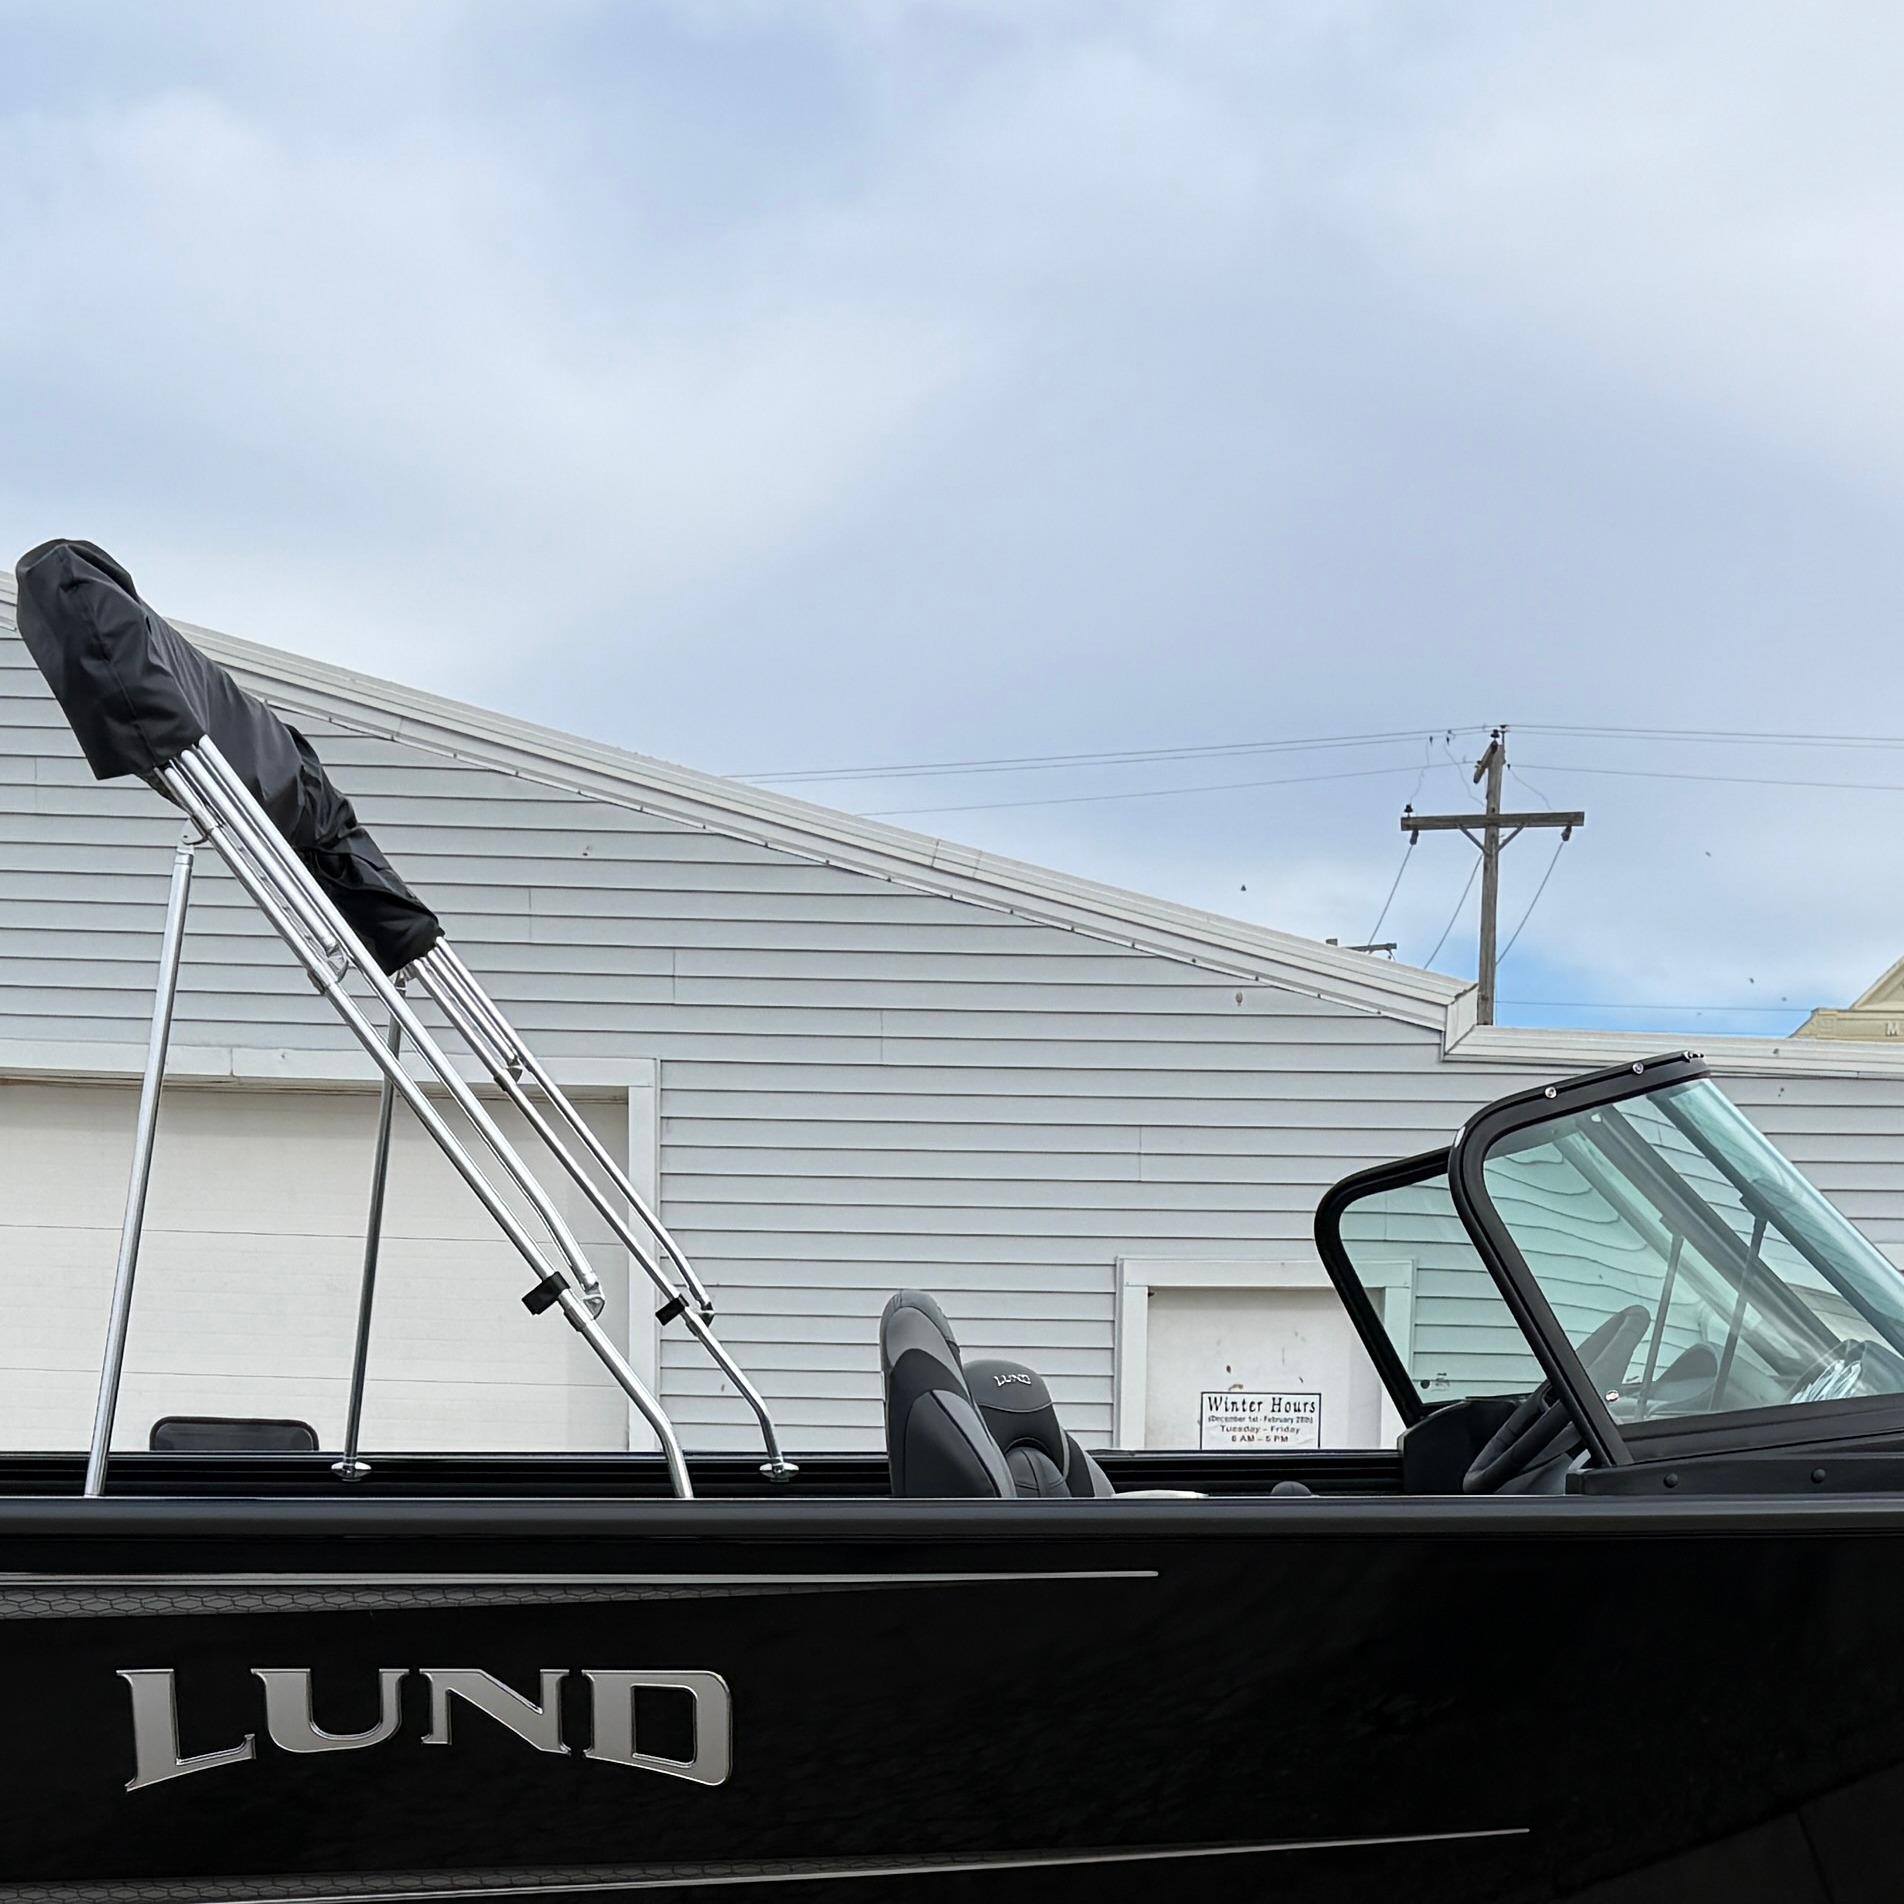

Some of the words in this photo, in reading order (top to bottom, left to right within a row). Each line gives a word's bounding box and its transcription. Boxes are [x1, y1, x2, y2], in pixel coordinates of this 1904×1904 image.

[1208, 1396, 1263, 1413] Winter
[1271, 1396, 1316, 1413] Hours
[1220, 1424, 1261, 1433] Tuesday
[1271, 1425, 1301, 1434] Friday
[116, 1668, 733, 1792] LUND
